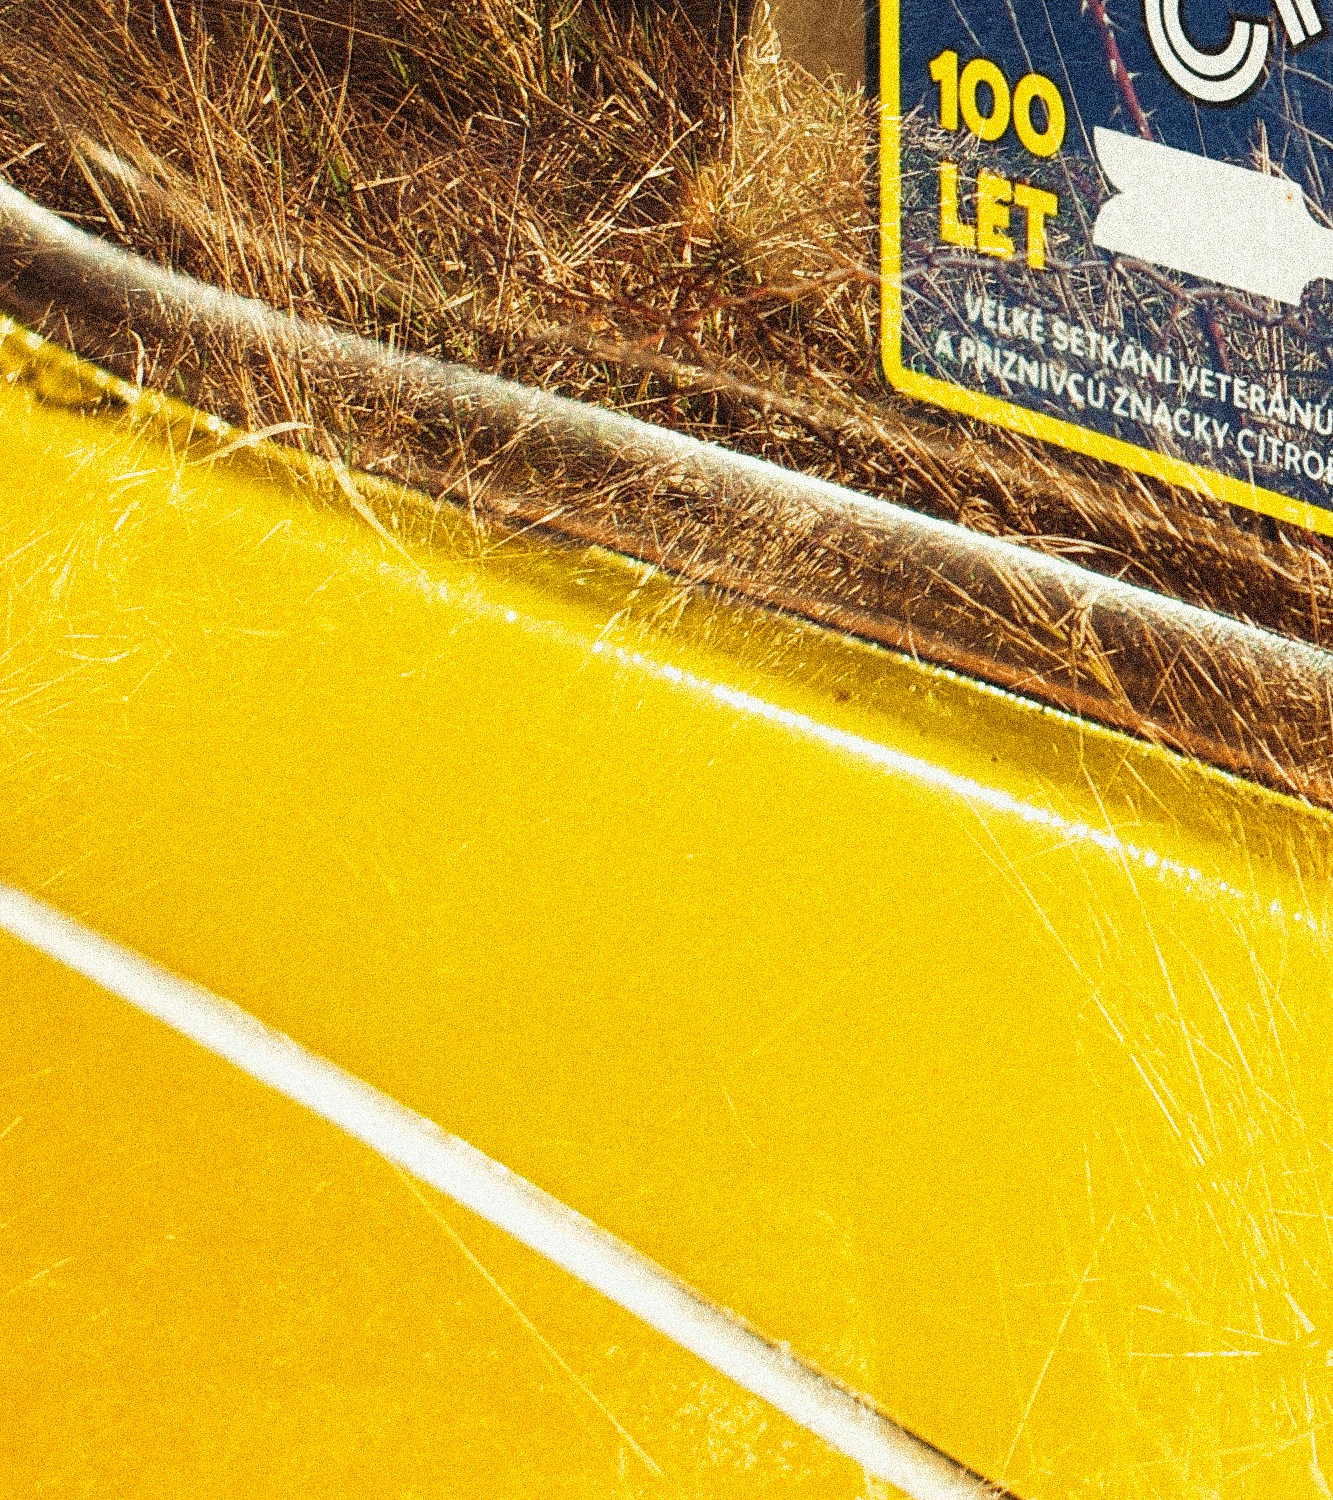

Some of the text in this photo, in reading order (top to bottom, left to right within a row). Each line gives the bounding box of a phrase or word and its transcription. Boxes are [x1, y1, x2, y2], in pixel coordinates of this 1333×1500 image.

[929, 49, 1066, 159] 100
[939, 161, 1058, 270] LET
[935, 331, 953, 360] A
